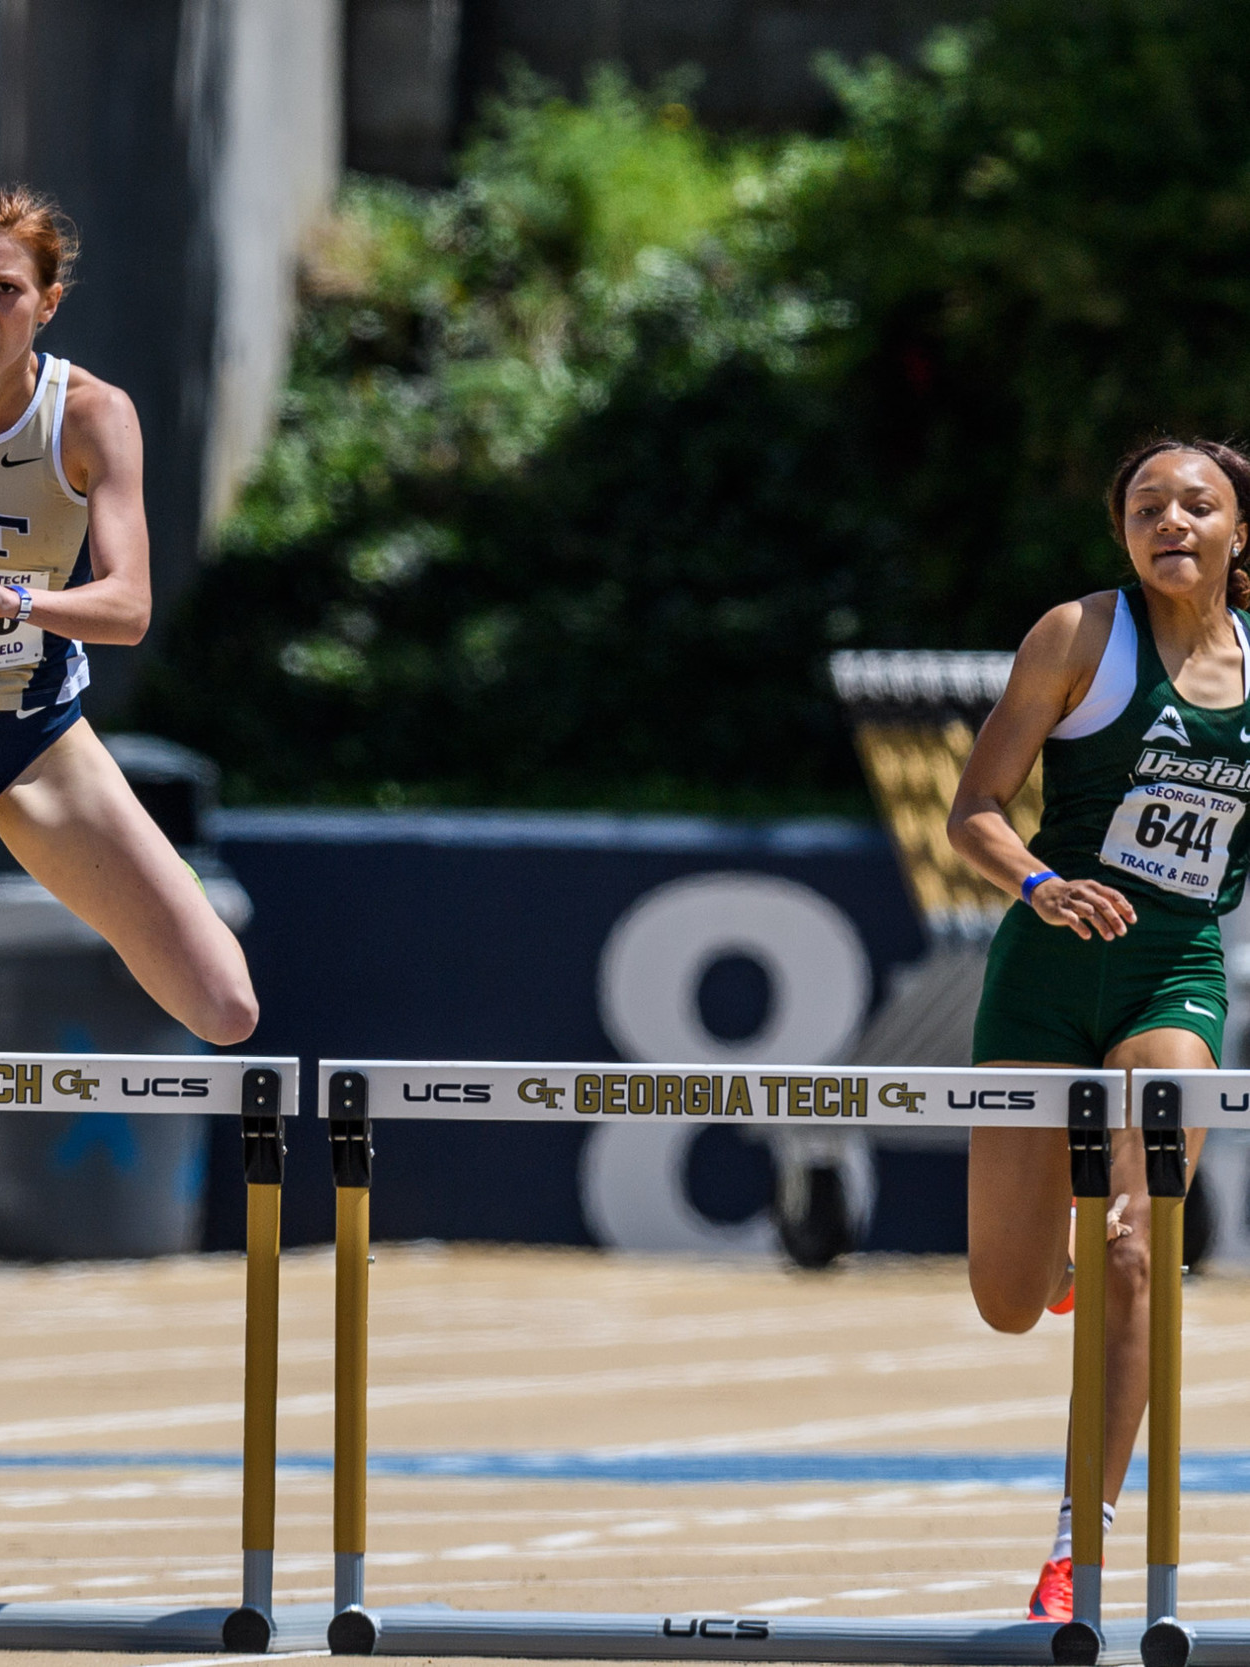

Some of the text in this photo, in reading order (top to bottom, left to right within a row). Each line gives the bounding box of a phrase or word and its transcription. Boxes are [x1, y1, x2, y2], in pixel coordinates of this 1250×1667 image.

[1145, 785, 1236, 813] GEORGIA TECH
[1135, 803, 1218, 863] 644
[1120, 852, 1164, 877] TRACK
[1167, 868, 1177, 880] &
[1181, 871, 1209, 887] FIELD
[121, 1077, 209, 1097] UCS
[403, 1083, 491, 1103] UCS
[575, 1074, 753, 1115] GEORGIA
[760, 1077, 868, 1117] TECH
[948, 1090, 1036, 1110] UCS
[663, 1618, 769, 1638] UCS
